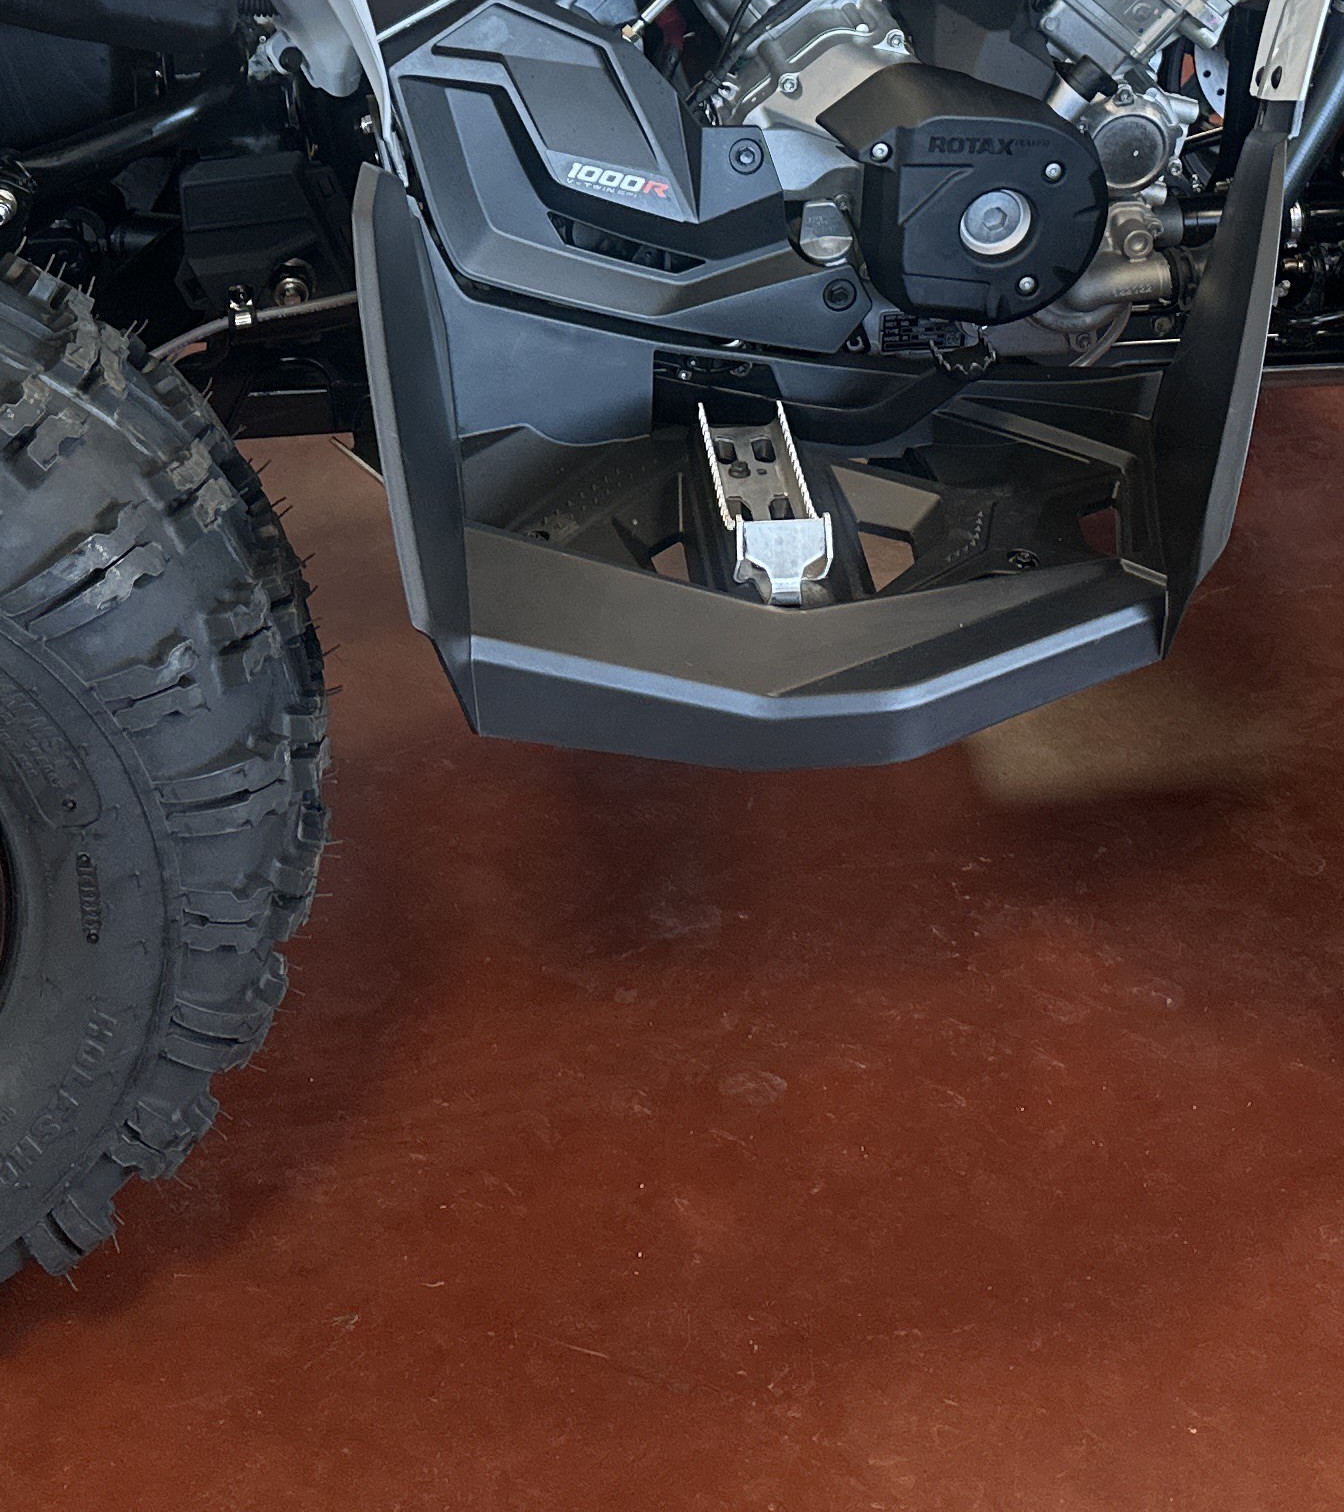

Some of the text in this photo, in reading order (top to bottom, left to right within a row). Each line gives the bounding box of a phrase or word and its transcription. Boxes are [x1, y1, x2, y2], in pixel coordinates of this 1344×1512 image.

[927, 135, 1015, 156] ROTAX
[565, 177, 616, 195] V-TWIN
[567, 162, 670, 199] 1000R
